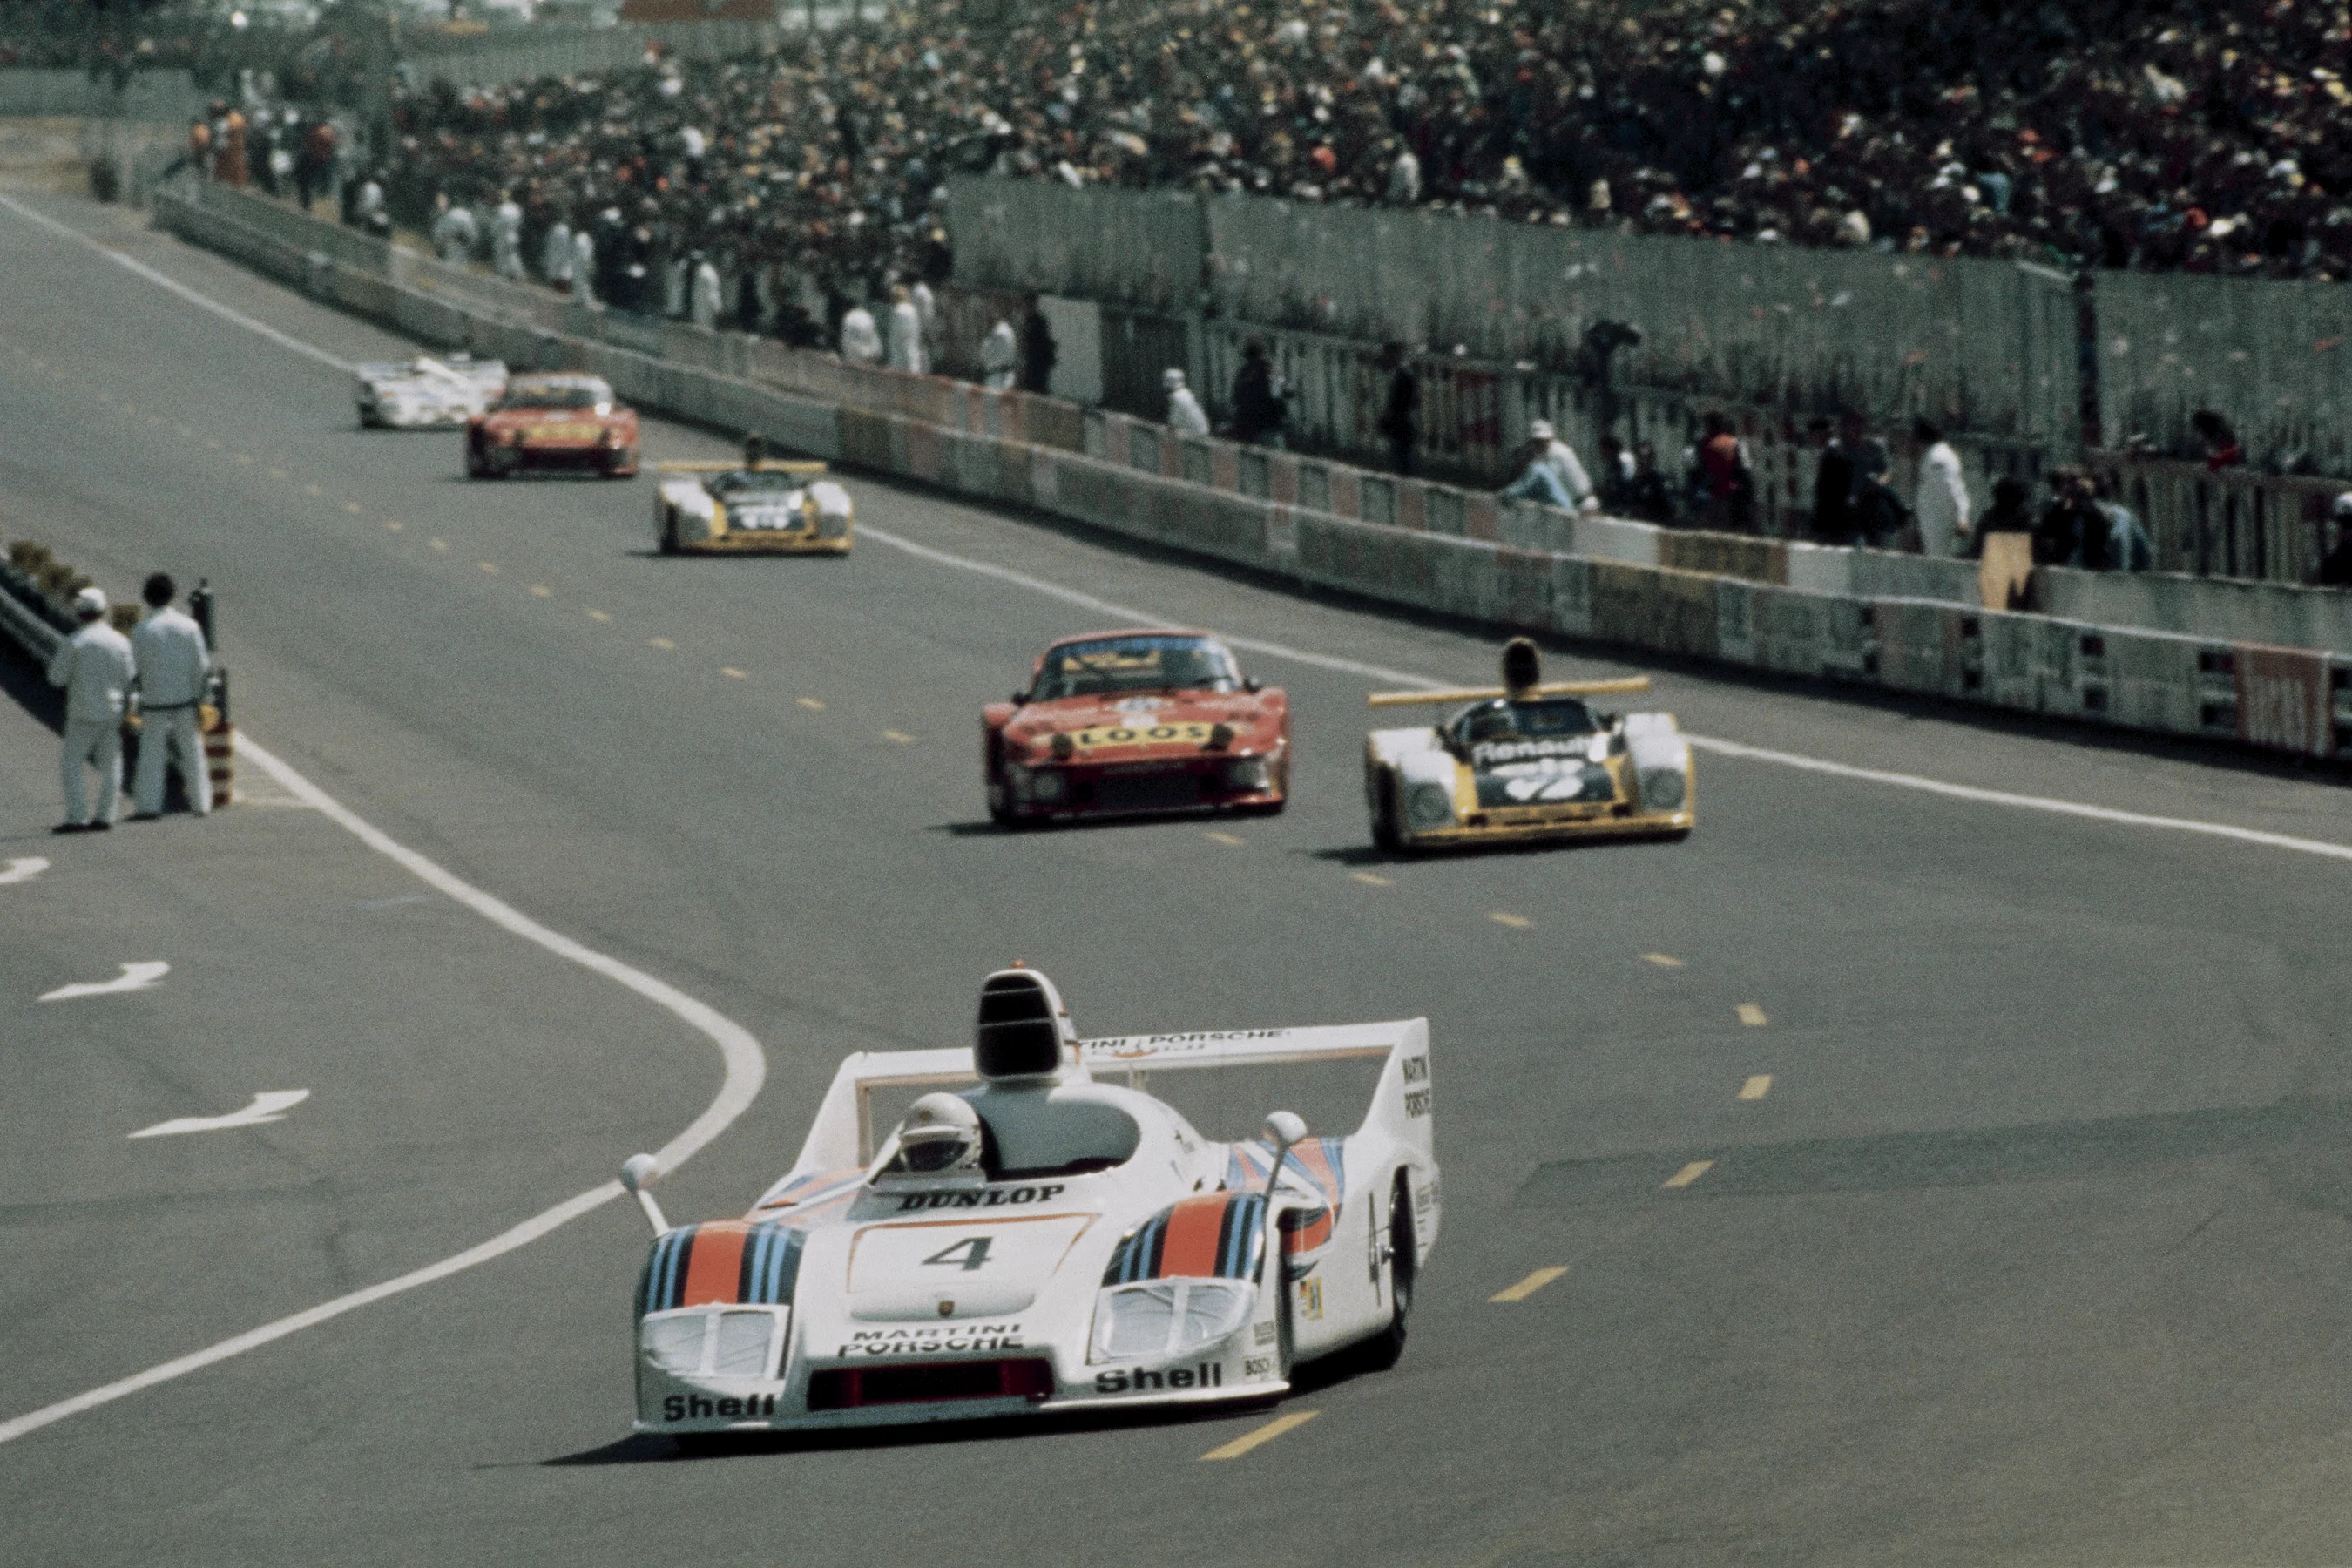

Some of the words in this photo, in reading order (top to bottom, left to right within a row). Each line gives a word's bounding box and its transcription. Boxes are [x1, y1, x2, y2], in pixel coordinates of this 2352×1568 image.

[1079, 723, 1206, 747] LOOS
[1149, 1030, 1287, 1044] PORSCHE
[896, 1183, 1065, 1213] DUNLOP
[921, 1236, 993, 1271] 4
[853, 1323, 1021, 1341] MARTINI
[837, 1335, 1024, 1358] PORSCHE
[1095, 1362, 1221, 1393] Shell
[664, 1394, 775, 1422] Shell
